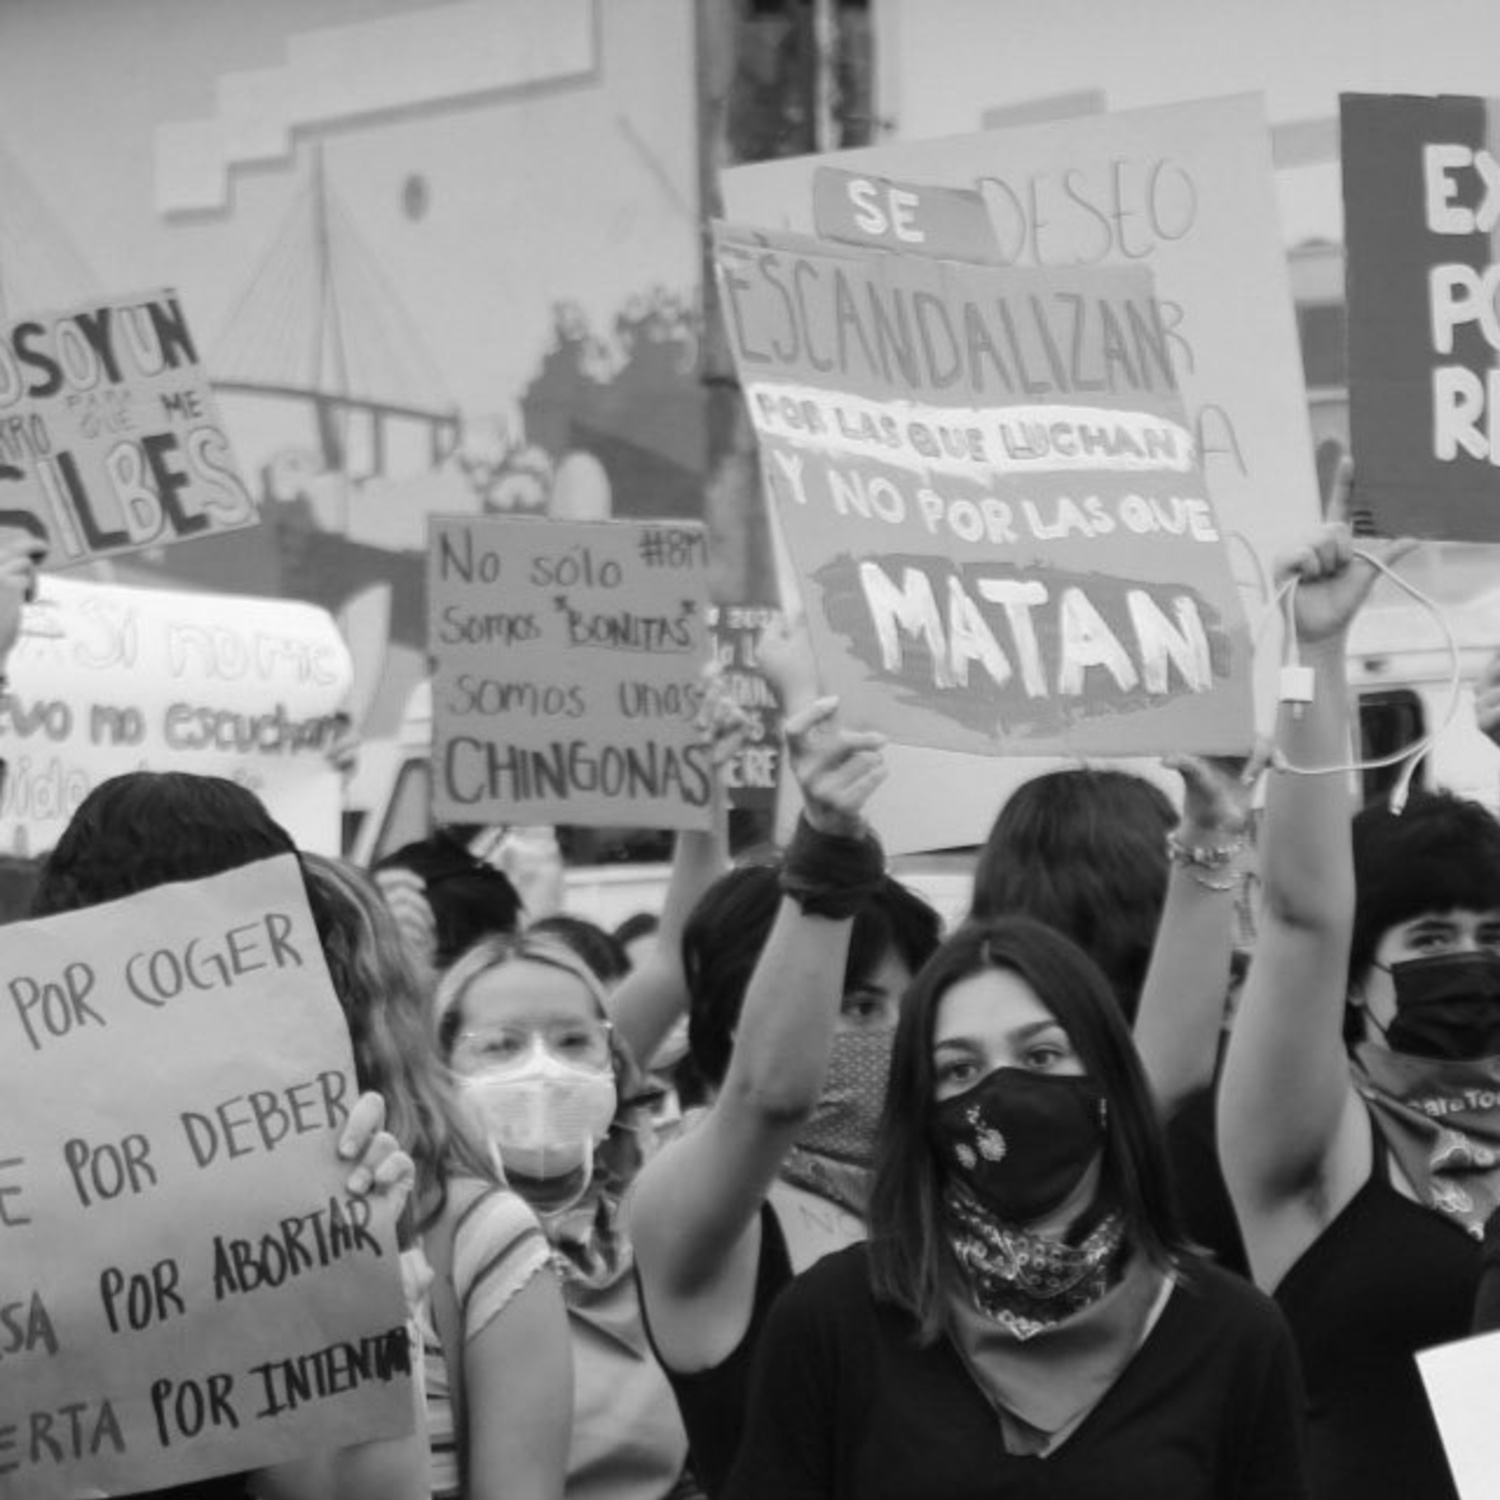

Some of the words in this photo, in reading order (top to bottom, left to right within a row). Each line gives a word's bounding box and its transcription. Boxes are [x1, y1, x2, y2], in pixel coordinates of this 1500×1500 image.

[846, 178, 925, 243] SE
[976, 156, 1201, 267] DESEO
[720, 250, 1177, 394] ESCANDALIZAN
[774, 448, 807, 503] Y
[826, 469, 906, 524] NO
[916, 488, 1016, 544] POR
[1023, 496, 1117, 540] LAS
[1118, 493, 1220, 542] QUE
[440, 528, 500, 585] No
[859, 561, 1213, 699] MATAN
[444, 736, 712, 808] CHINGONAS
[8, 962, 106, 1051] POR
[125, 913, 304, 1008] COGER
[64, 1133, 158, 1208] POR
[180, 1070, 349, 1169] DEBER
[0, 1289, 60, 1357] SA
[100, 1258, 186, 1333] POR
[213, 1197, 383, 1300] ABORTAR
[0, 1397, 126, 1475] ERTA
[151, 1373, 240, 1447] POR
